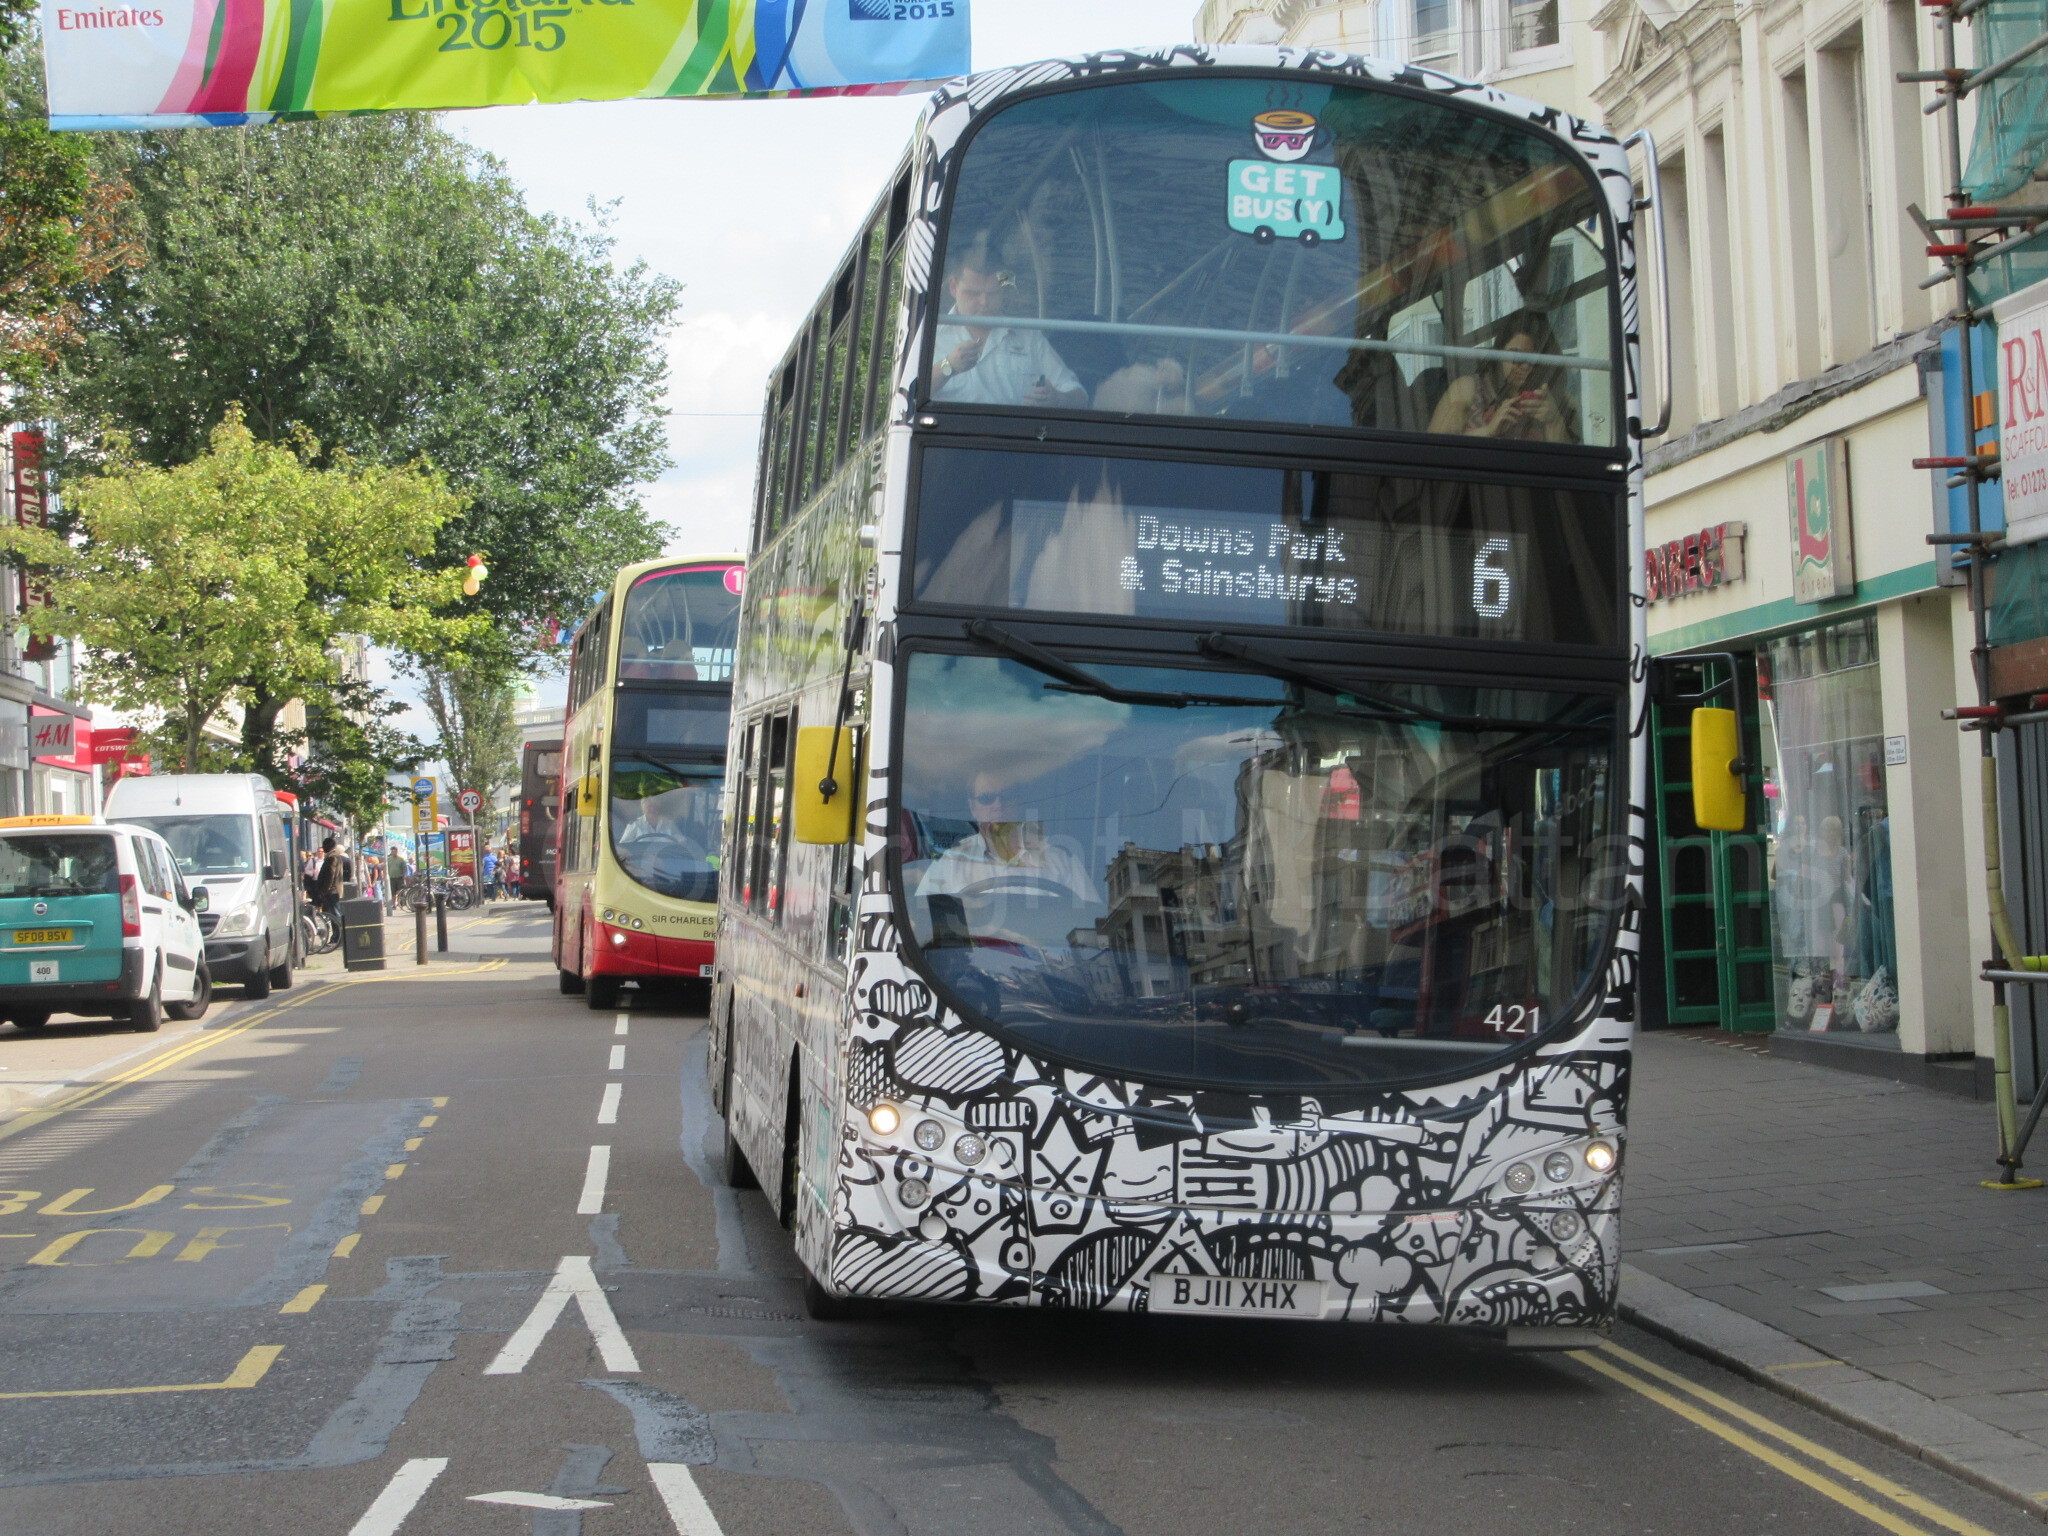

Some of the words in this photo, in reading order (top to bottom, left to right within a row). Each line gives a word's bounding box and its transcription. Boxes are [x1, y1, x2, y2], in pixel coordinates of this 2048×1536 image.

[58, 6, 164, 30] Emirates
[893, 1, 955, 20] 2015
[436, 7, 573, 52] 2015
[1240, 165, 1326, 197] GET
[1233, 195, 1334, 226] BUS(Y)
[2020, 468, 2047, 496] 01273
[1137, 514, 1255, 556] Downs
[1267, 523, 1347, 562] Park
[1645, 523, 1735, 601] DIRECT
[1119, 555, 1146, 591] &
[1162, 558, 1358, 604] Sainsburys
[1472, 538, 1510, 619] 6
[35, 723, 71, 748] H&M
[462, 795, 479, 806] 20
[28, 817, 61, 825] TAXI
[651, 915, 667, 923] SIR
[670, 916, 715, 925] CHARLES
[17, 931, 44, 942] SF08
[47, 930, 67, 941] BSV
[36, 967, 51, 975] 400
[1483, 1004, 1540, 1034] 421
[1240, 1281, 1298, 1310] XHX
